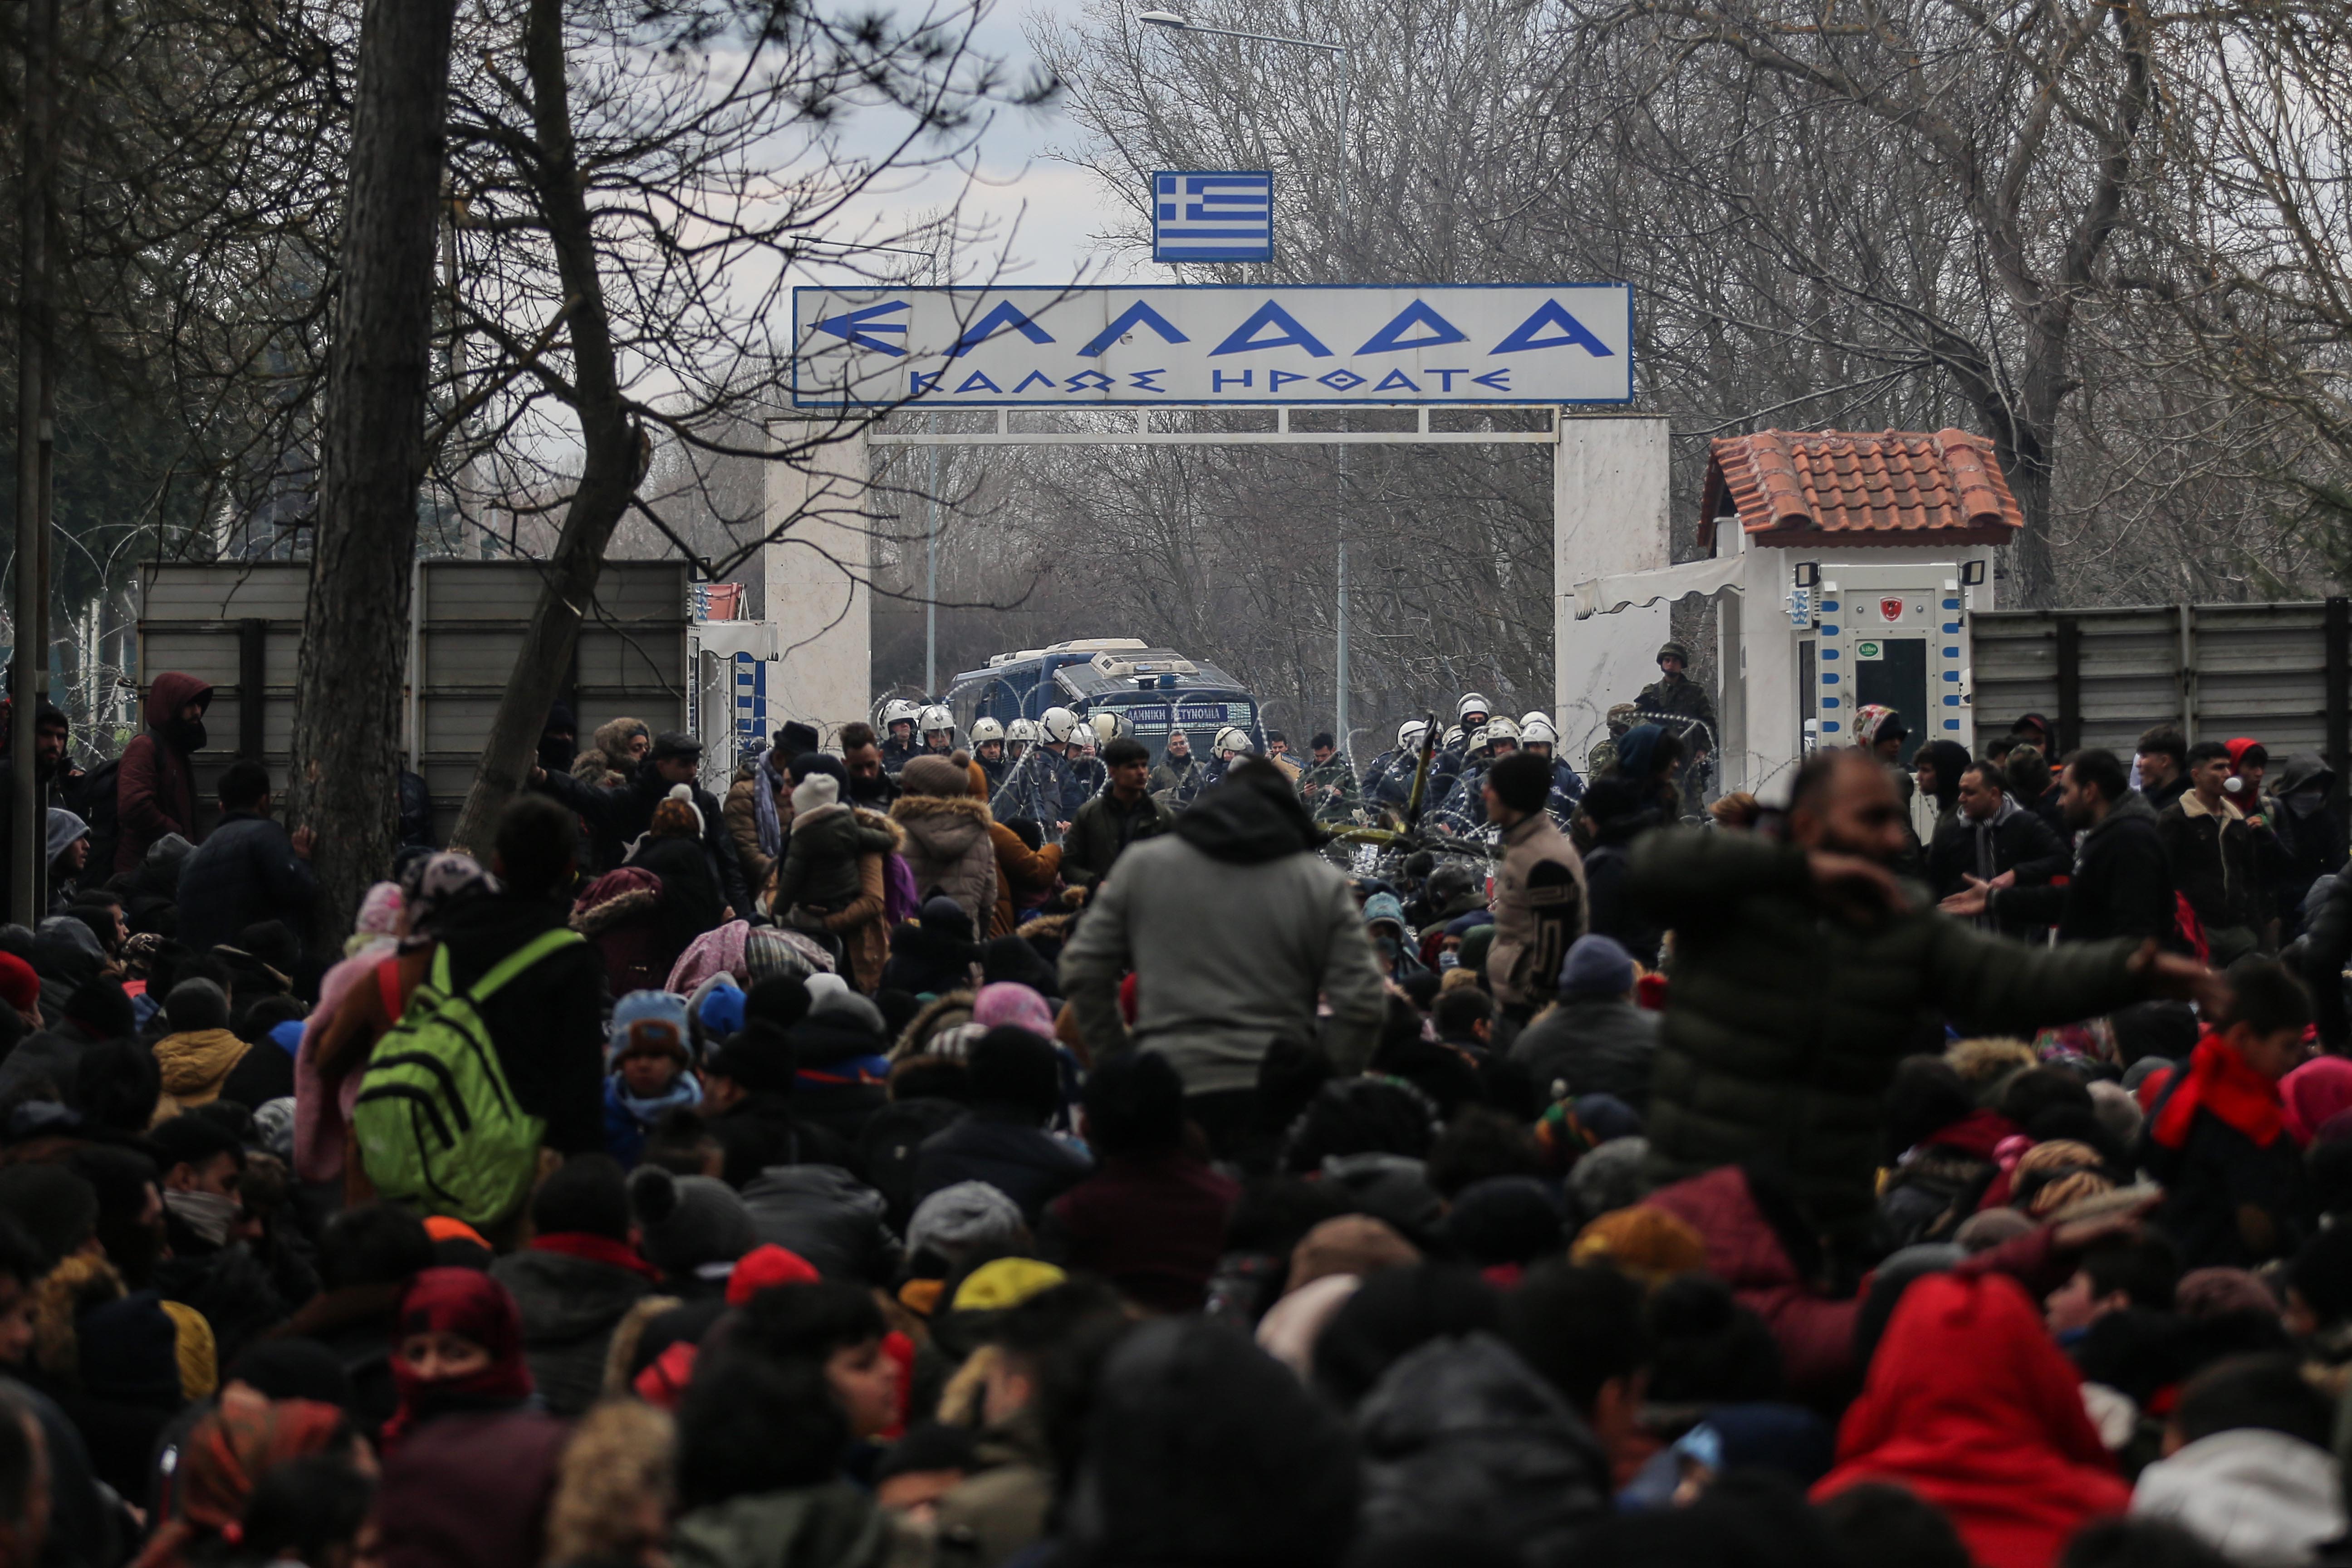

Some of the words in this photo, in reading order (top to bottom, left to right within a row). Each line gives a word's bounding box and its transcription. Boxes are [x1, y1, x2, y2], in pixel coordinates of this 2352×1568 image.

[806, 299, 1613, 358] ΕΛΛΑΔΑ
[910, 369, 1165, 394] ΚΑΛΩΣ
[1213, 368, 1510, 392] ΗΡΘΑΤΕ
